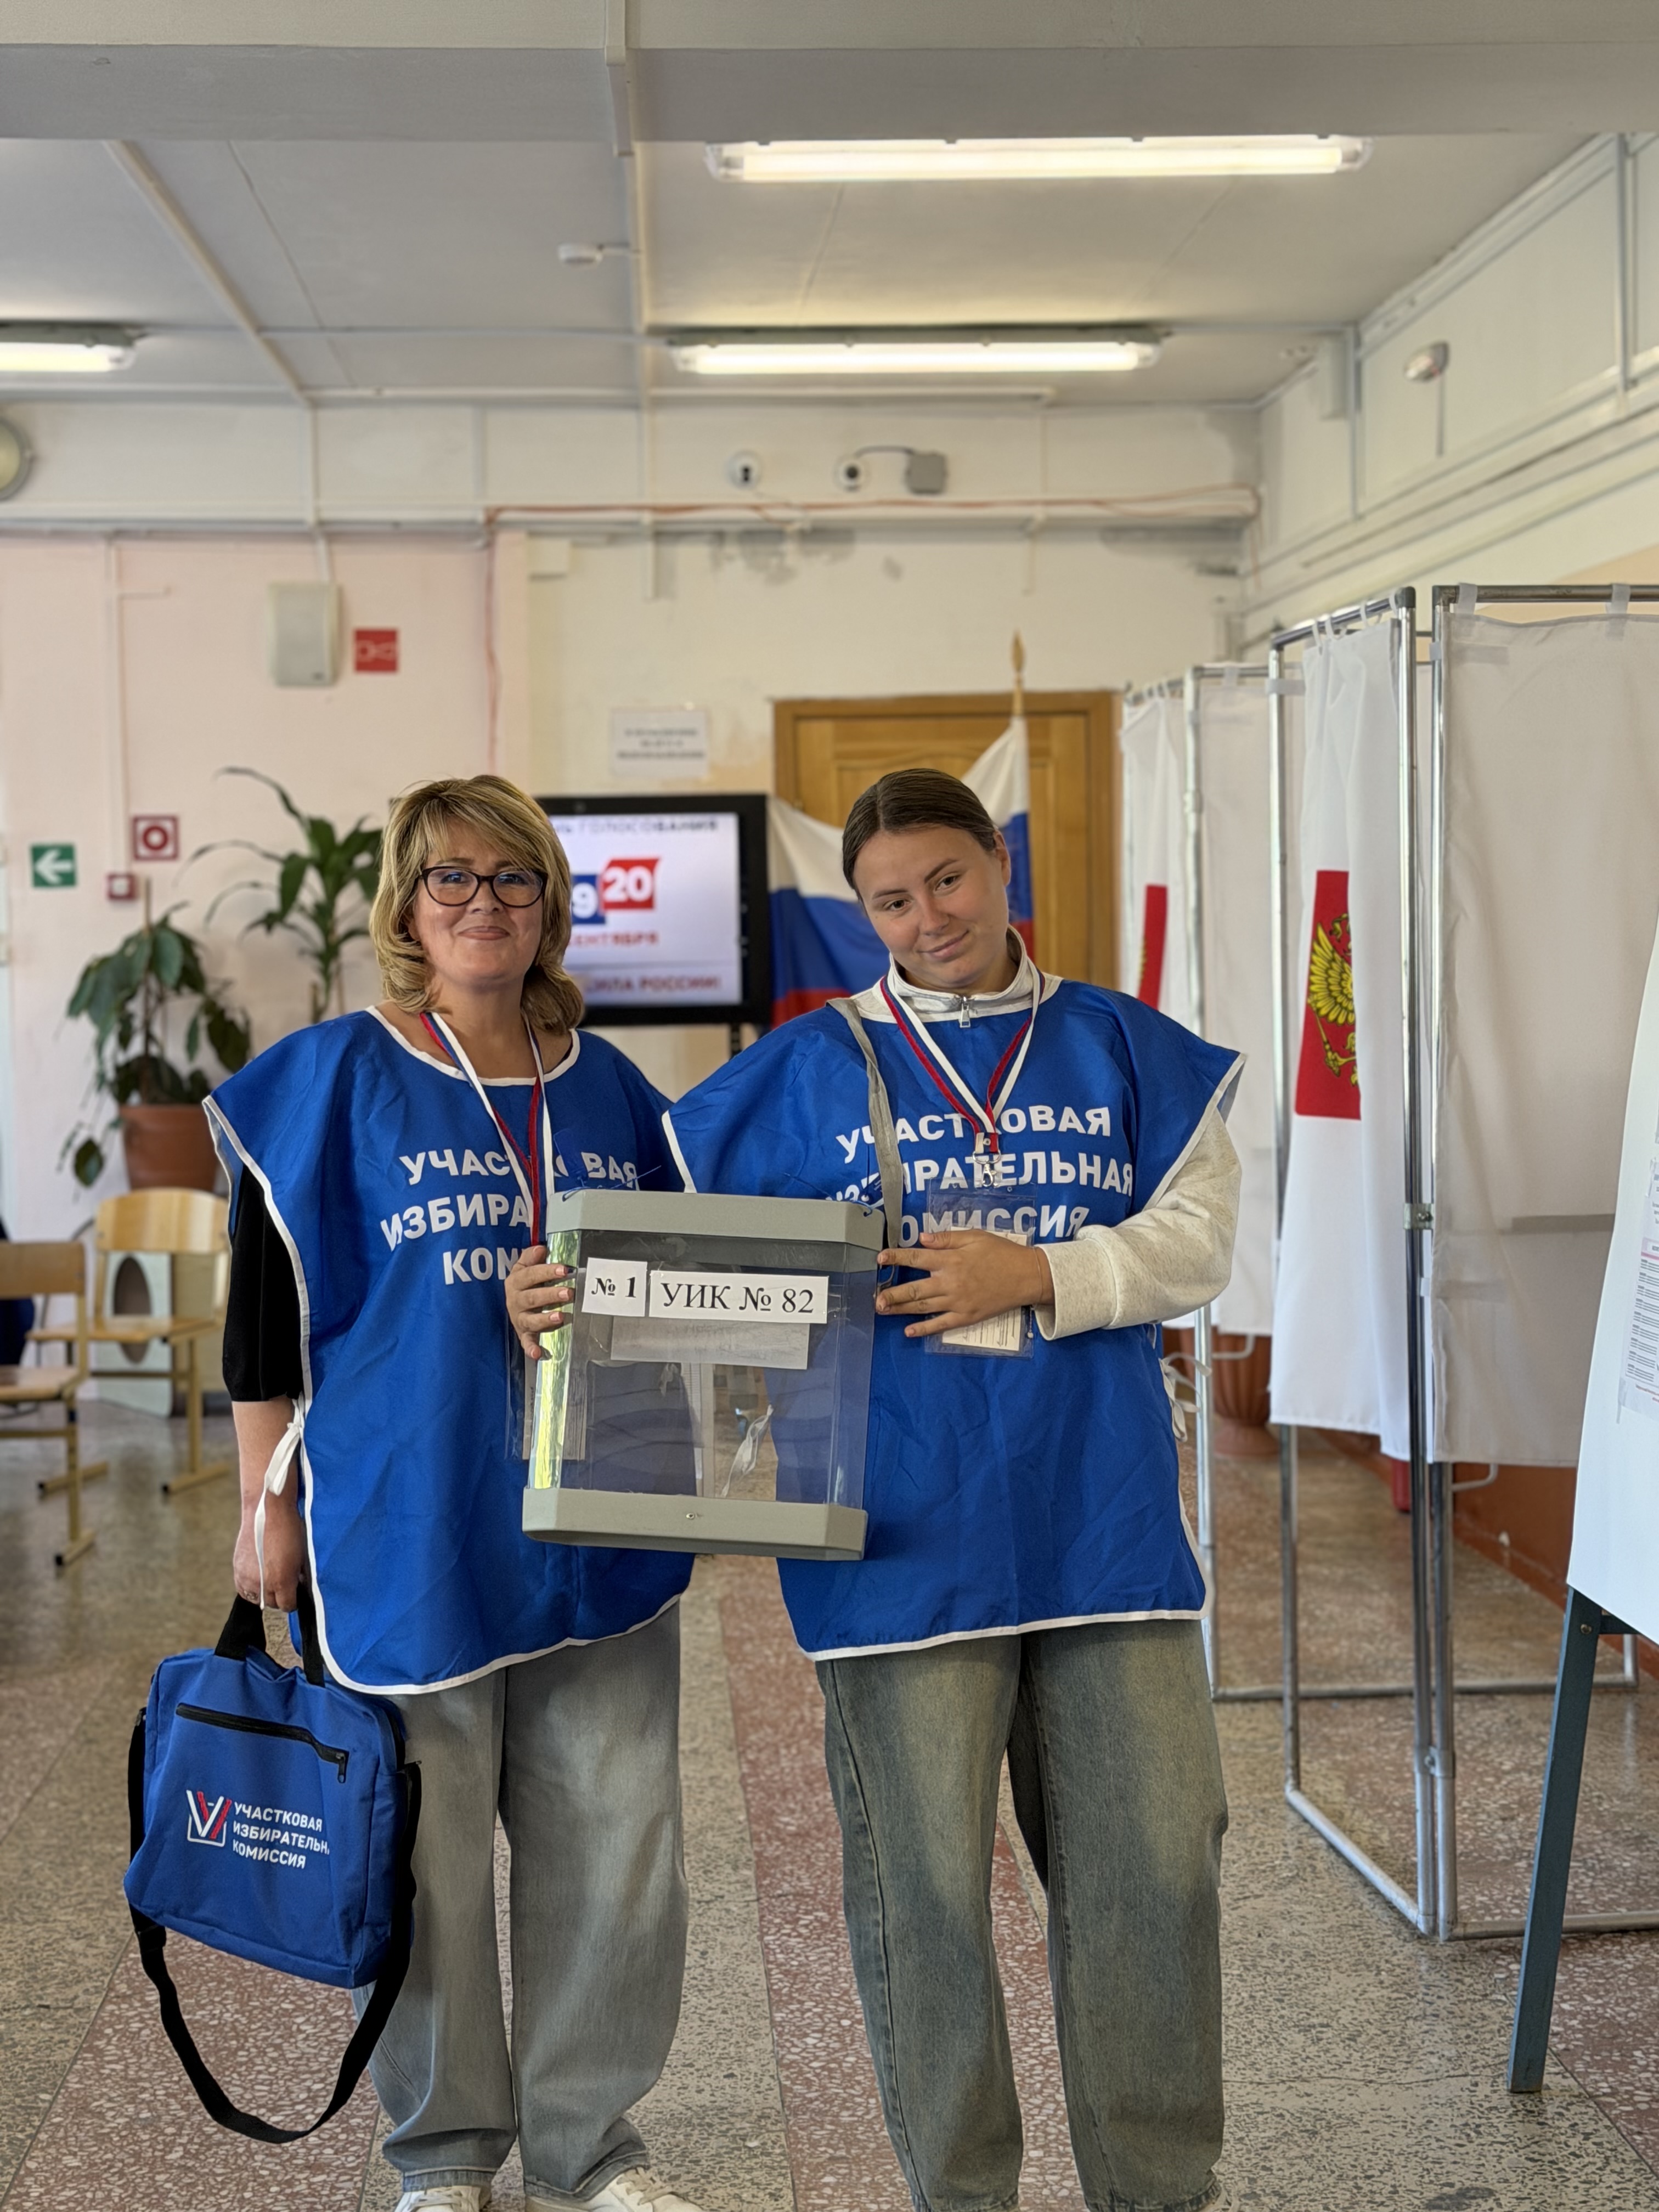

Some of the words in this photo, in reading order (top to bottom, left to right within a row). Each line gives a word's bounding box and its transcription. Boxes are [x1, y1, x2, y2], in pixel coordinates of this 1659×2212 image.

[603, 866, 653, 901] 20
[836, 1105, 1111, 1164] УАСТОВАЯ
[399, 1149, 640, 1191] УЧАСВАЯ
[825, 1150, 1133, 1201] РАТЕЛЬНАЯ
[380, 1193, 531, 1251] ИЗБИРА
[898, 1205, 1090, 1248] ОМИССИЯ
[443, 1246, 525, 1285] КОМ
[591, 1277, 616, 1296] №
[625, 1277, 637, 1298] 1
[660, 1283, 731, 1310] УИК
[738, 1287, 771, 1312] №
[782, 1289, 814, 1313] 82
[234, 1802, 323, 1832] УЧАСТКОВАЯ
[233, 1820, 330, 1855] ИЗБИРАТЕЛЬН
[233, 1839, 306, 1869] КОМИССИЯ
